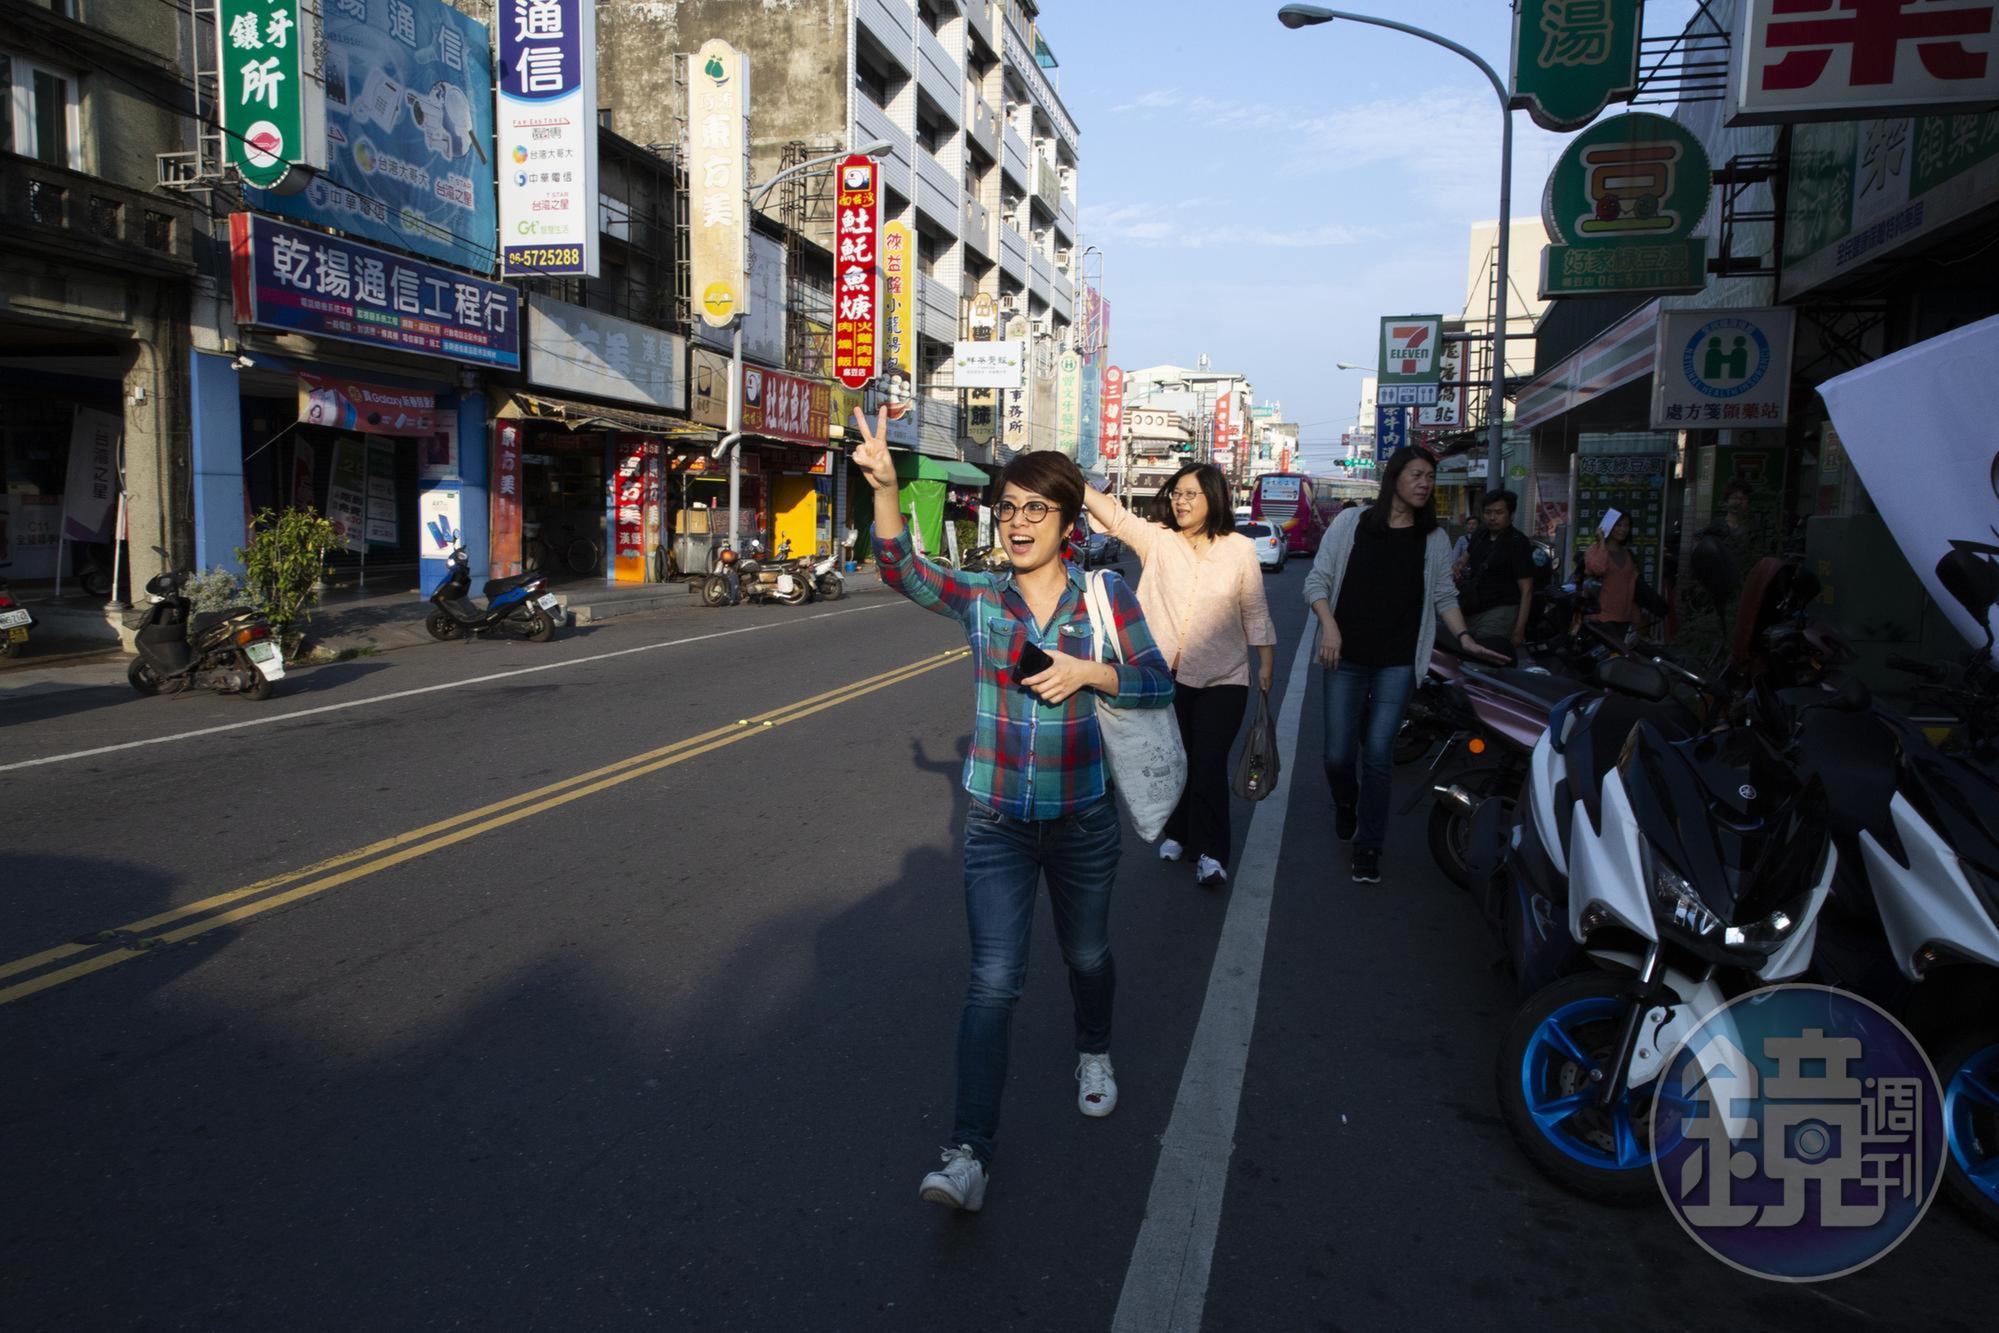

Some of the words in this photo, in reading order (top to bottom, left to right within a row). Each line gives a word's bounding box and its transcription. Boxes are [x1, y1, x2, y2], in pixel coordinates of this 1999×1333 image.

[1538, 0, 1614, 68] 湯
[529, 171, 573, 183] 中華電信
[508, 248, 580, 267] 06-5725288
[271, 234, 509, 333] 乾揚通信工程行
[1665, 403, 1779, 421] 處方箋領藥站
